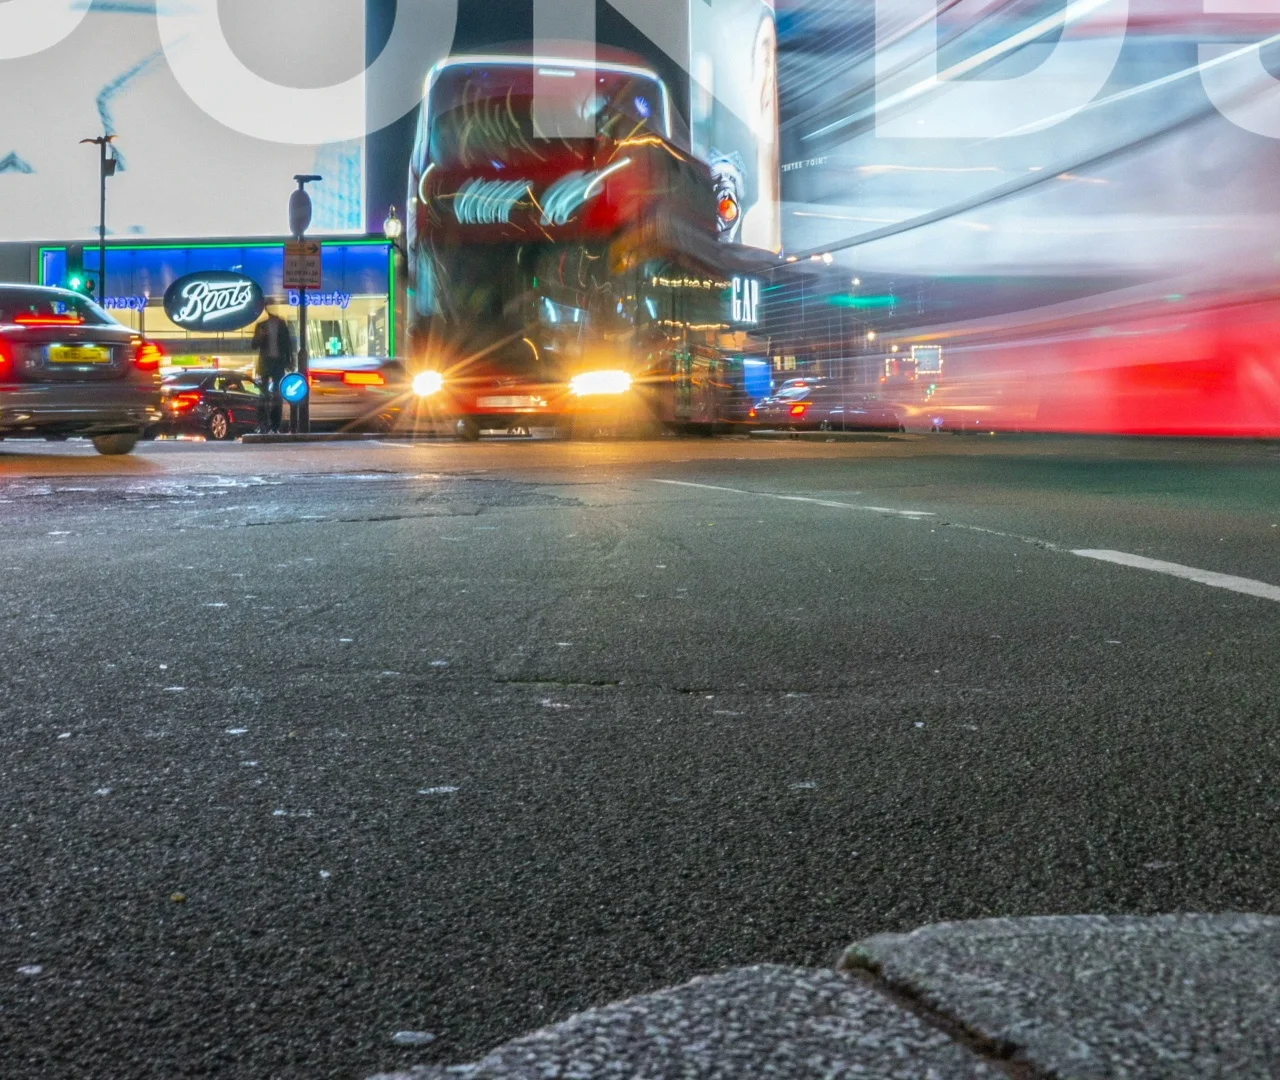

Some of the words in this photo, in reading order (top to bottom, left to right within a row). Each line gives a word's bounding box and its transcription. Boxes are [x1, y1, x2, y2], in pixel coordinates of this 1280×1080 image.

[57, 295, 148, 313] pmacy
[172, 280, 252, 322] Boots
[288, 289, 350, 309] beauty
[732, 277, 759, 323] GAP
